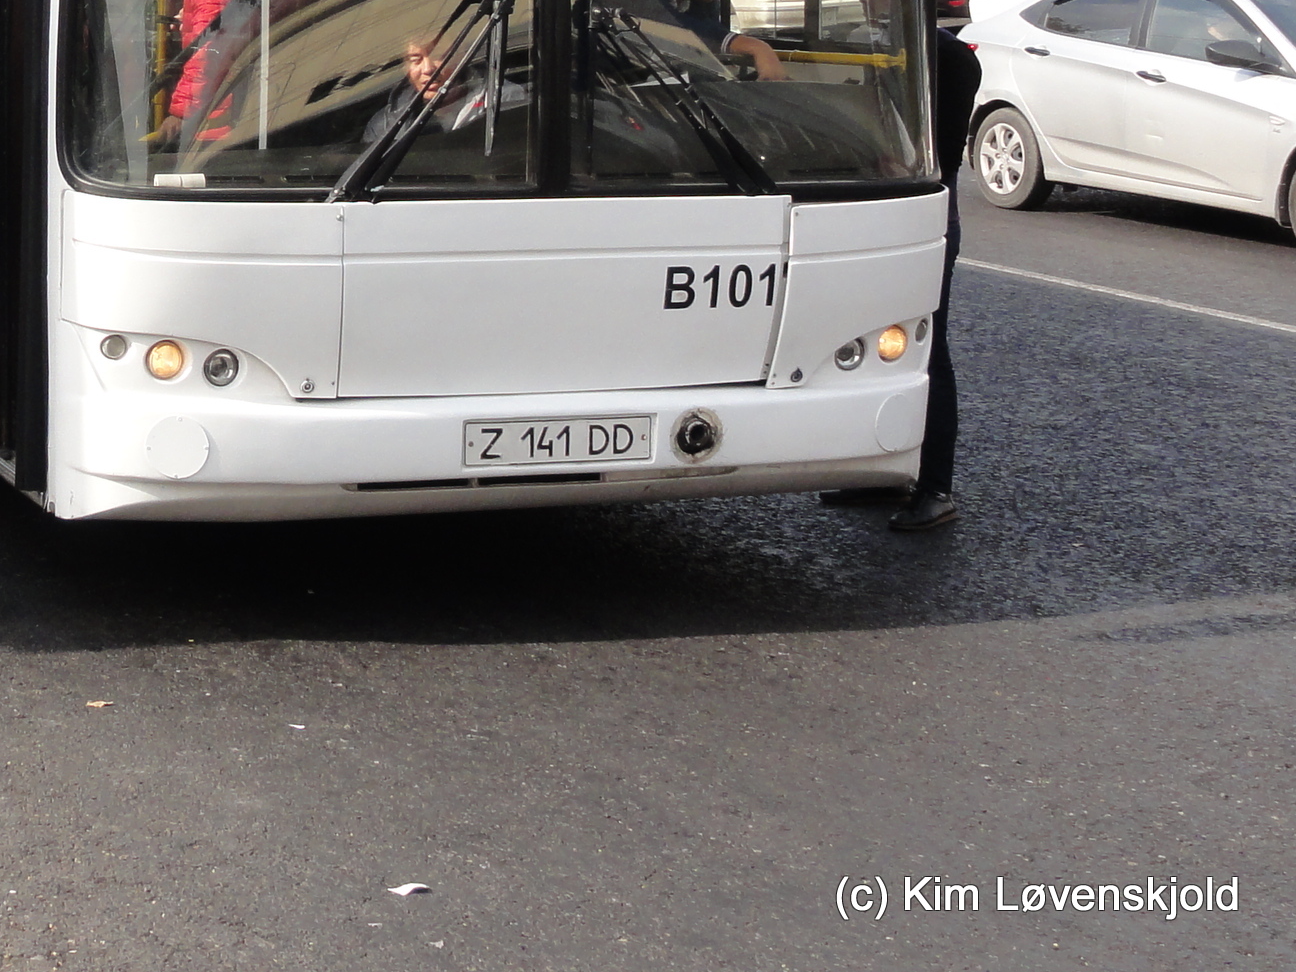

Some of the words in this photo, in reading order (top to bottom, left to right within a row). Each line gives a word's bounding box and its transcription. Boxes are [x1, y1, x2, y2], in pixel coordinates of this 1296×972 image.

[664, 263, 777, 309] B101
[480, 428, 503, 460] Z
[521, 425, 571, 458] 141
[588, 423, 634, 455] DD
